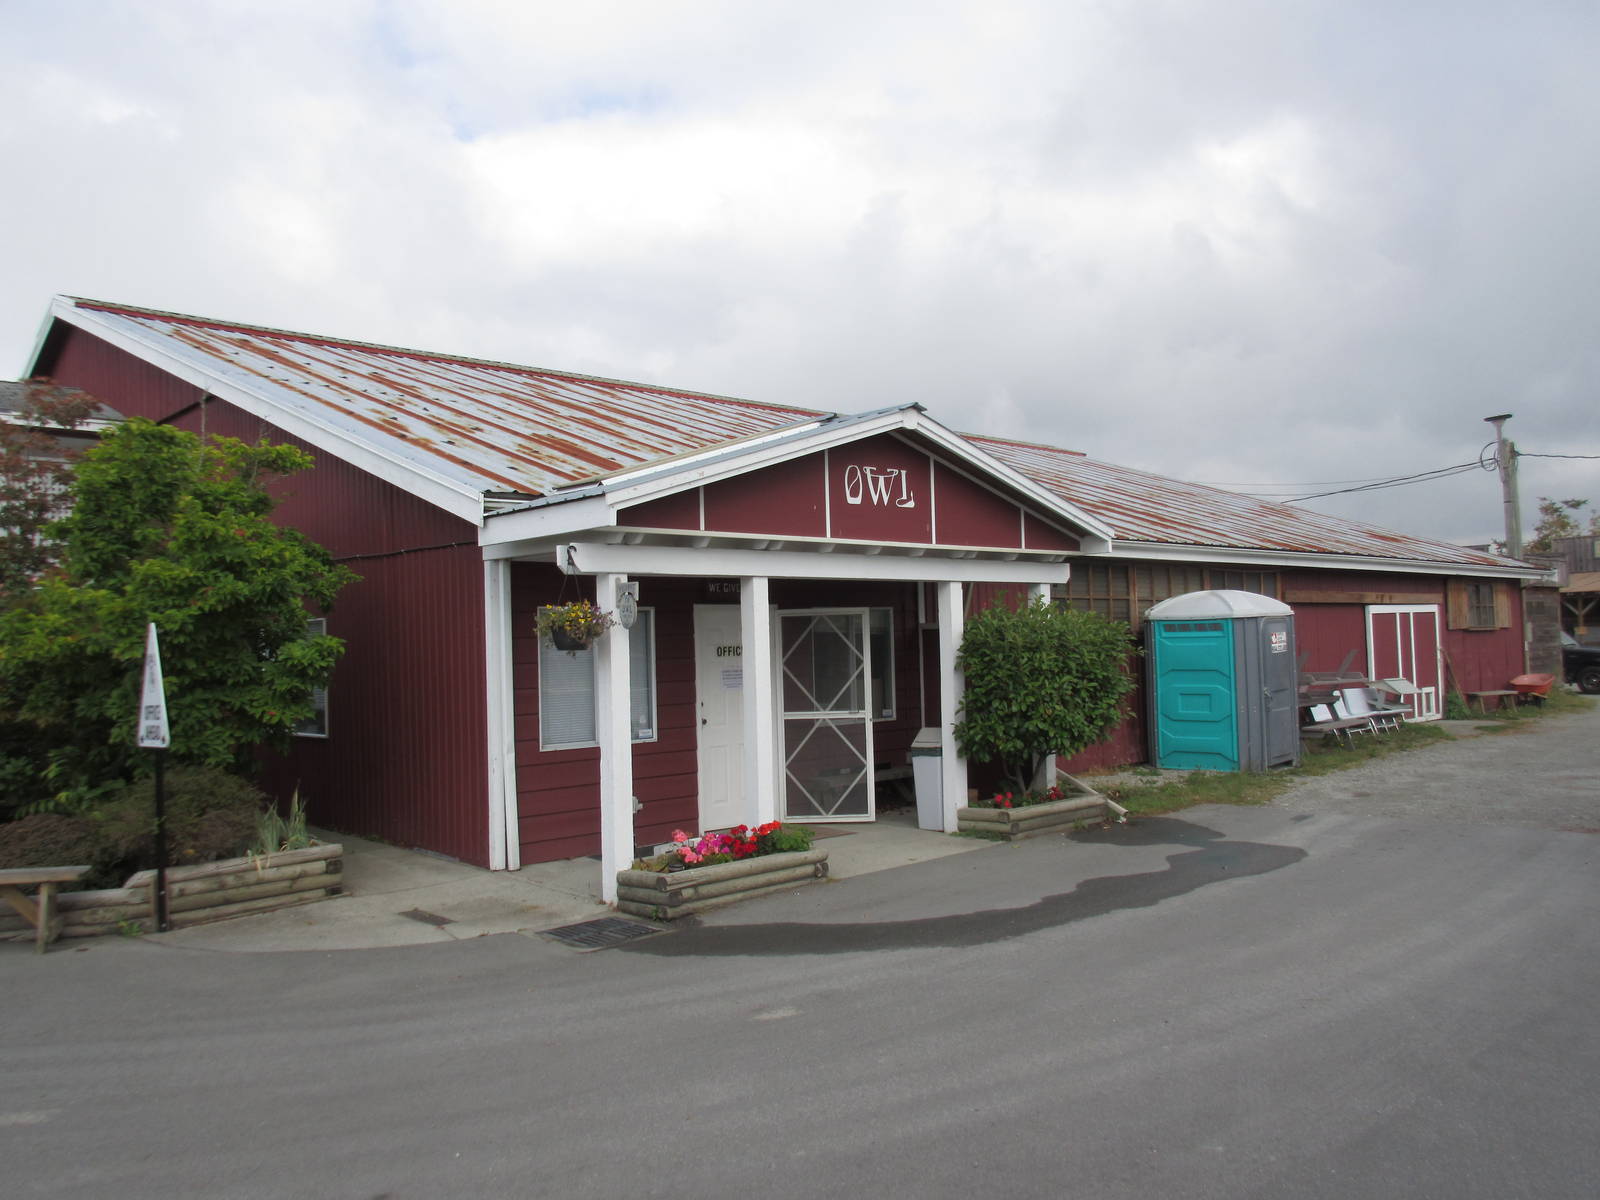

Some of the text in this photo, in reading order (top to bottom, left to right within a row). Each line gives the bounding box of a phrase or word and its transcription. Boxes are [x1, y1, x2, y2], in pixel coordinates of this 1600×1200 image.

[844, 464, 916, 508] OWL
[709, 583, 721, 593] WE
[716, 646, 743, 657] OFFIC
